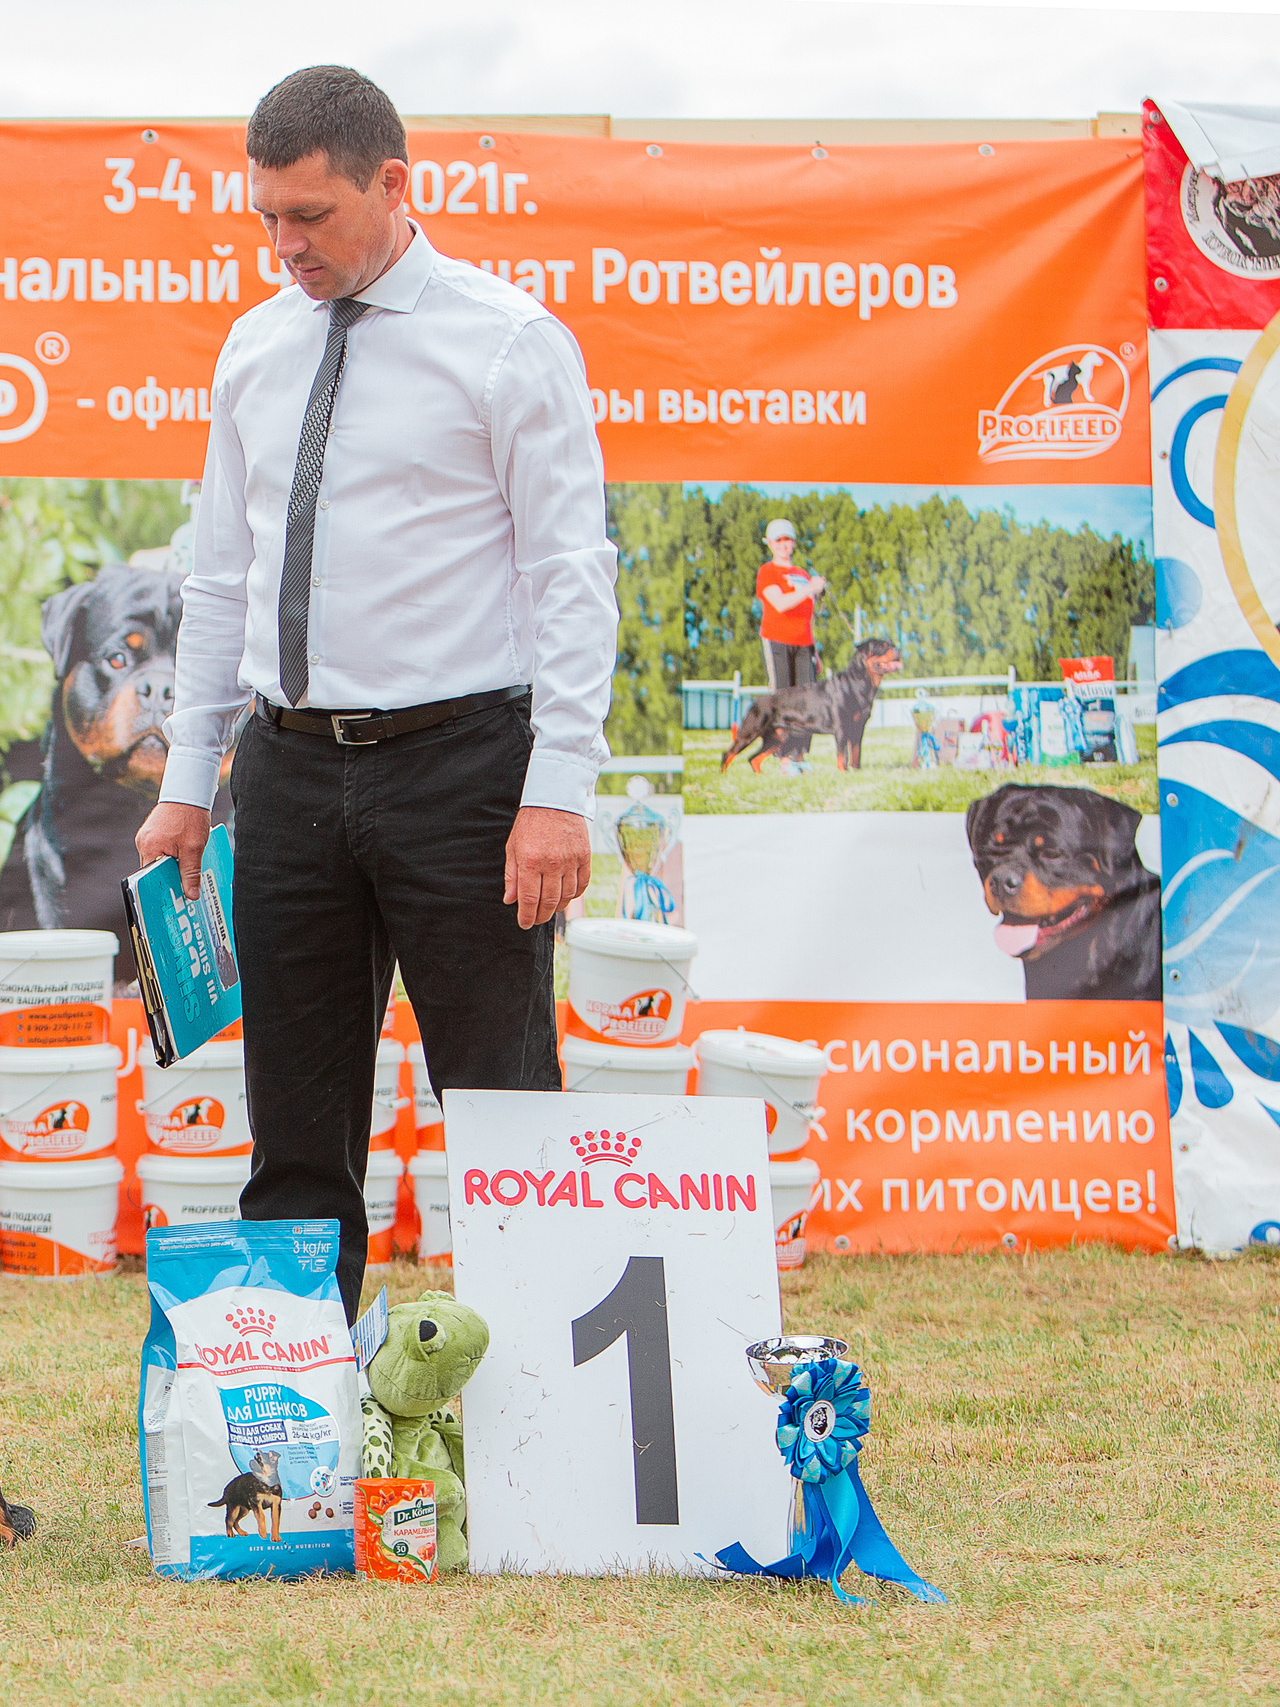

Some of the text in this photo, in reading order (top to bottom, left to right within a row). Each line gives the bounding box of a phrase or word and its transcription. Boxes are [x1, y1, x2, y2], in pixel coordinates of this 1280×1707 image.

[103, 157, 197, 214] 3-4
[403, 159, 538, 215] 021г.
[591, 246, 959, 320] Ротвейлеров
[658, 387, 867, 426] выставки
[979, 411, 1121, 440] PROFIFEED
[193, 921, 211, 976] Silver
[801, 1030, 1152, 1074] сиональный
[845, 1108, 1156, 1155] кормлению
[463, 1168, 758, 1212] ROYAL CANIN
[881, 1169, 1158, 1222] питомцев!
[293, 1240, 300, 1254] 3
[262, 1335, 330, 1363] CANIN
[243, 1386, 282, 1404] PUPPY
[571, 1256, 680, 1526] 1
[227, 1401, 308, 1423] ДЛЯ ЩЕНКОВ
[397, 1511, 412, 1523] Dr.
[395, 1545, 407, 1554] 30
